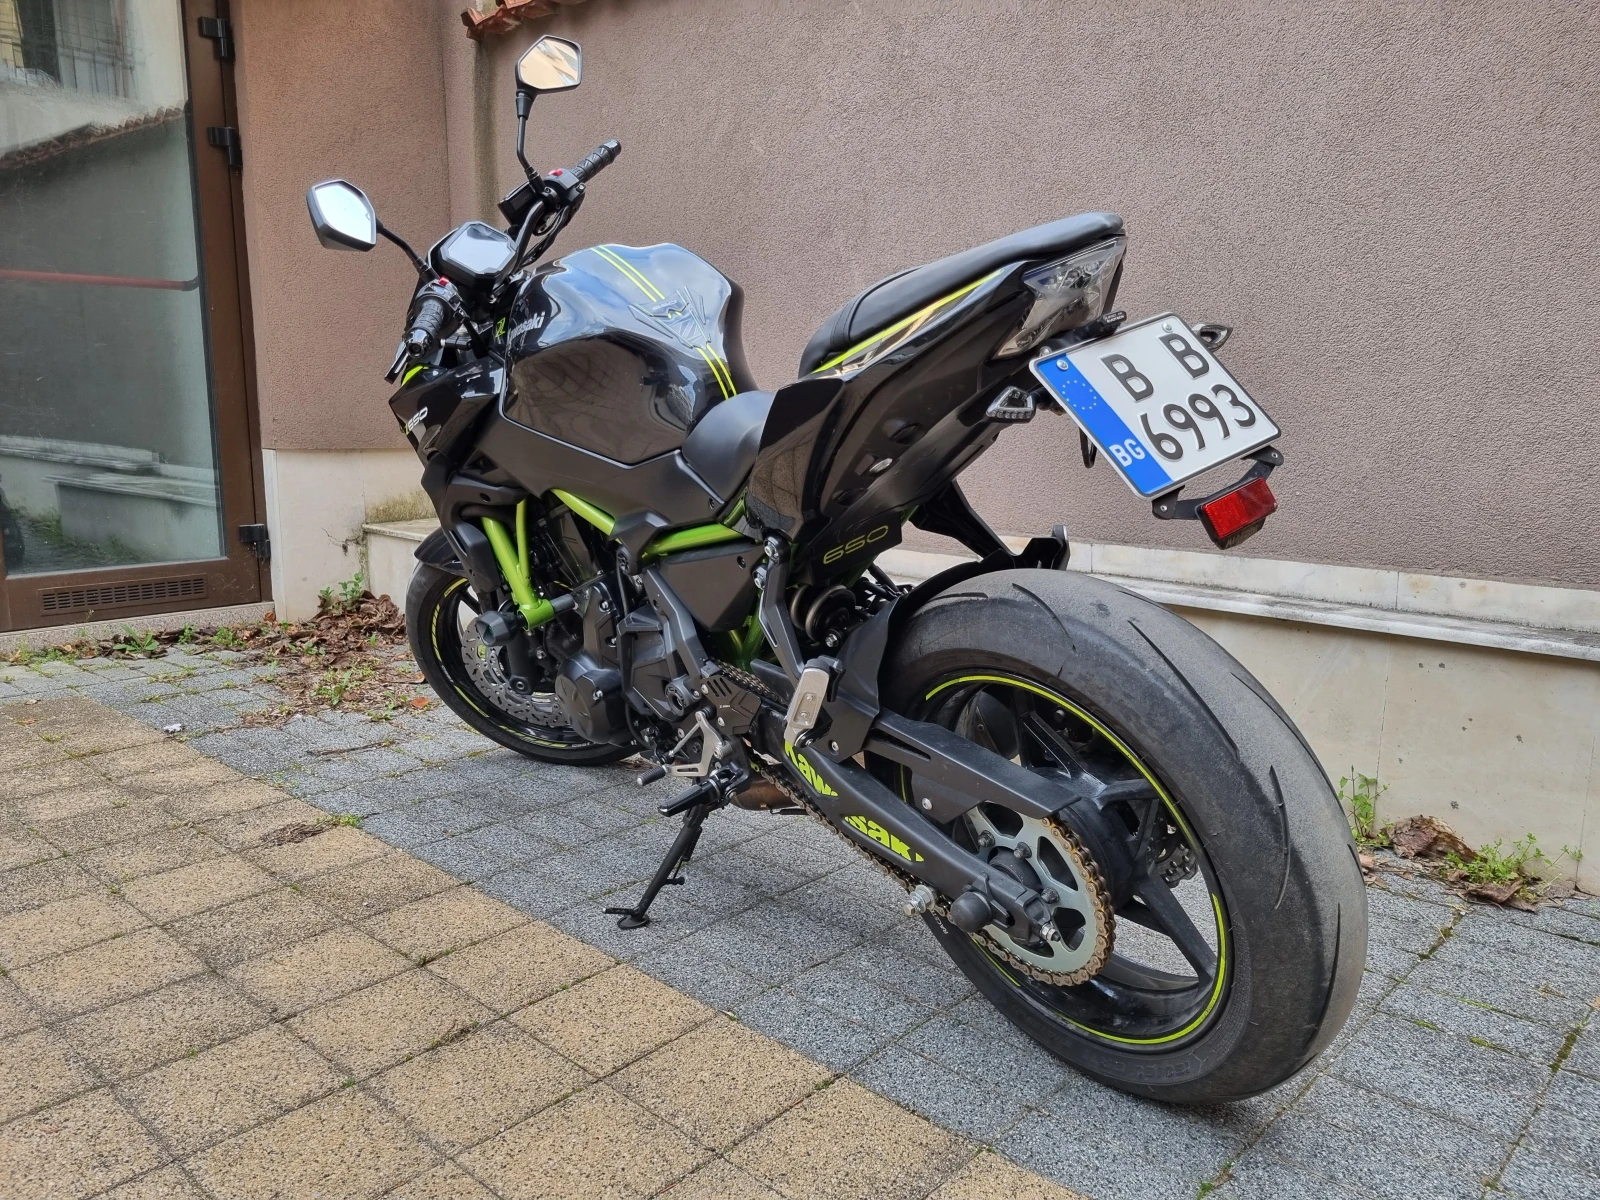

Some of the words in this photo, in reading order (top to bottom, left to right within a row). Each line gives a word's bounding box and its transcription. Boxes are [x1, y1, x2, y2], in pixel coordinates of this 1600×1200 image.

[507, 311, 546, 341] awasaki
[1102, 353, 1154, 401] B
[1159, 333, 1210, 379] B
[1139, 384, 1256, 460] 6993
[1109, 438, 1146, 467] BG
[823, 525, 889, 565] 650
